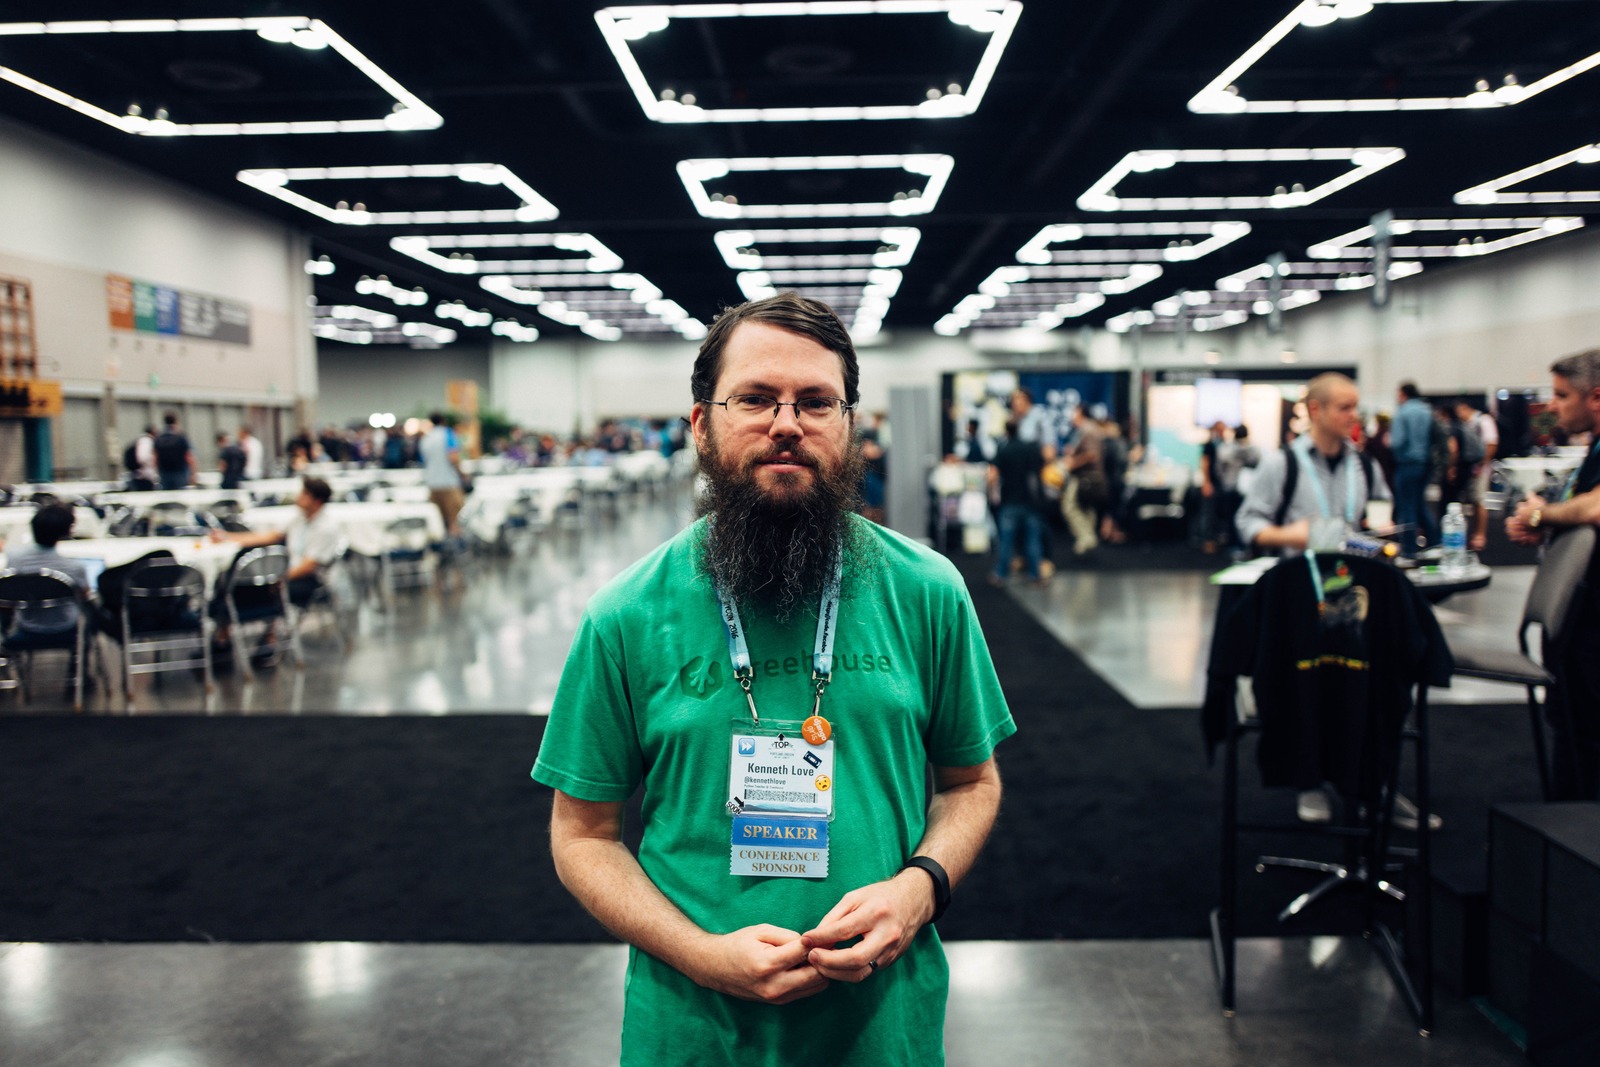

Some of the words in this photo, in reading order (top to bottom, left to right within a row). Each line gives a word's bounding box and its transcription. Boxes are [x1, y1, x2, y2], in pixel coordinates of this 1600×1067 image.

[729, 623, 739, 640] 2016
[774, 741, 790, 749] TOP
[747, 762, 788, 775] Kenneth
[791, 765, 815, 777] Love
[744, 776, 786, 785] @kennethlove
[743, 824, 818, 840] SPEAKER
[739, 849, 820, 862] CONFERENCE
[751, 862, 807, 874] SPONSOR
